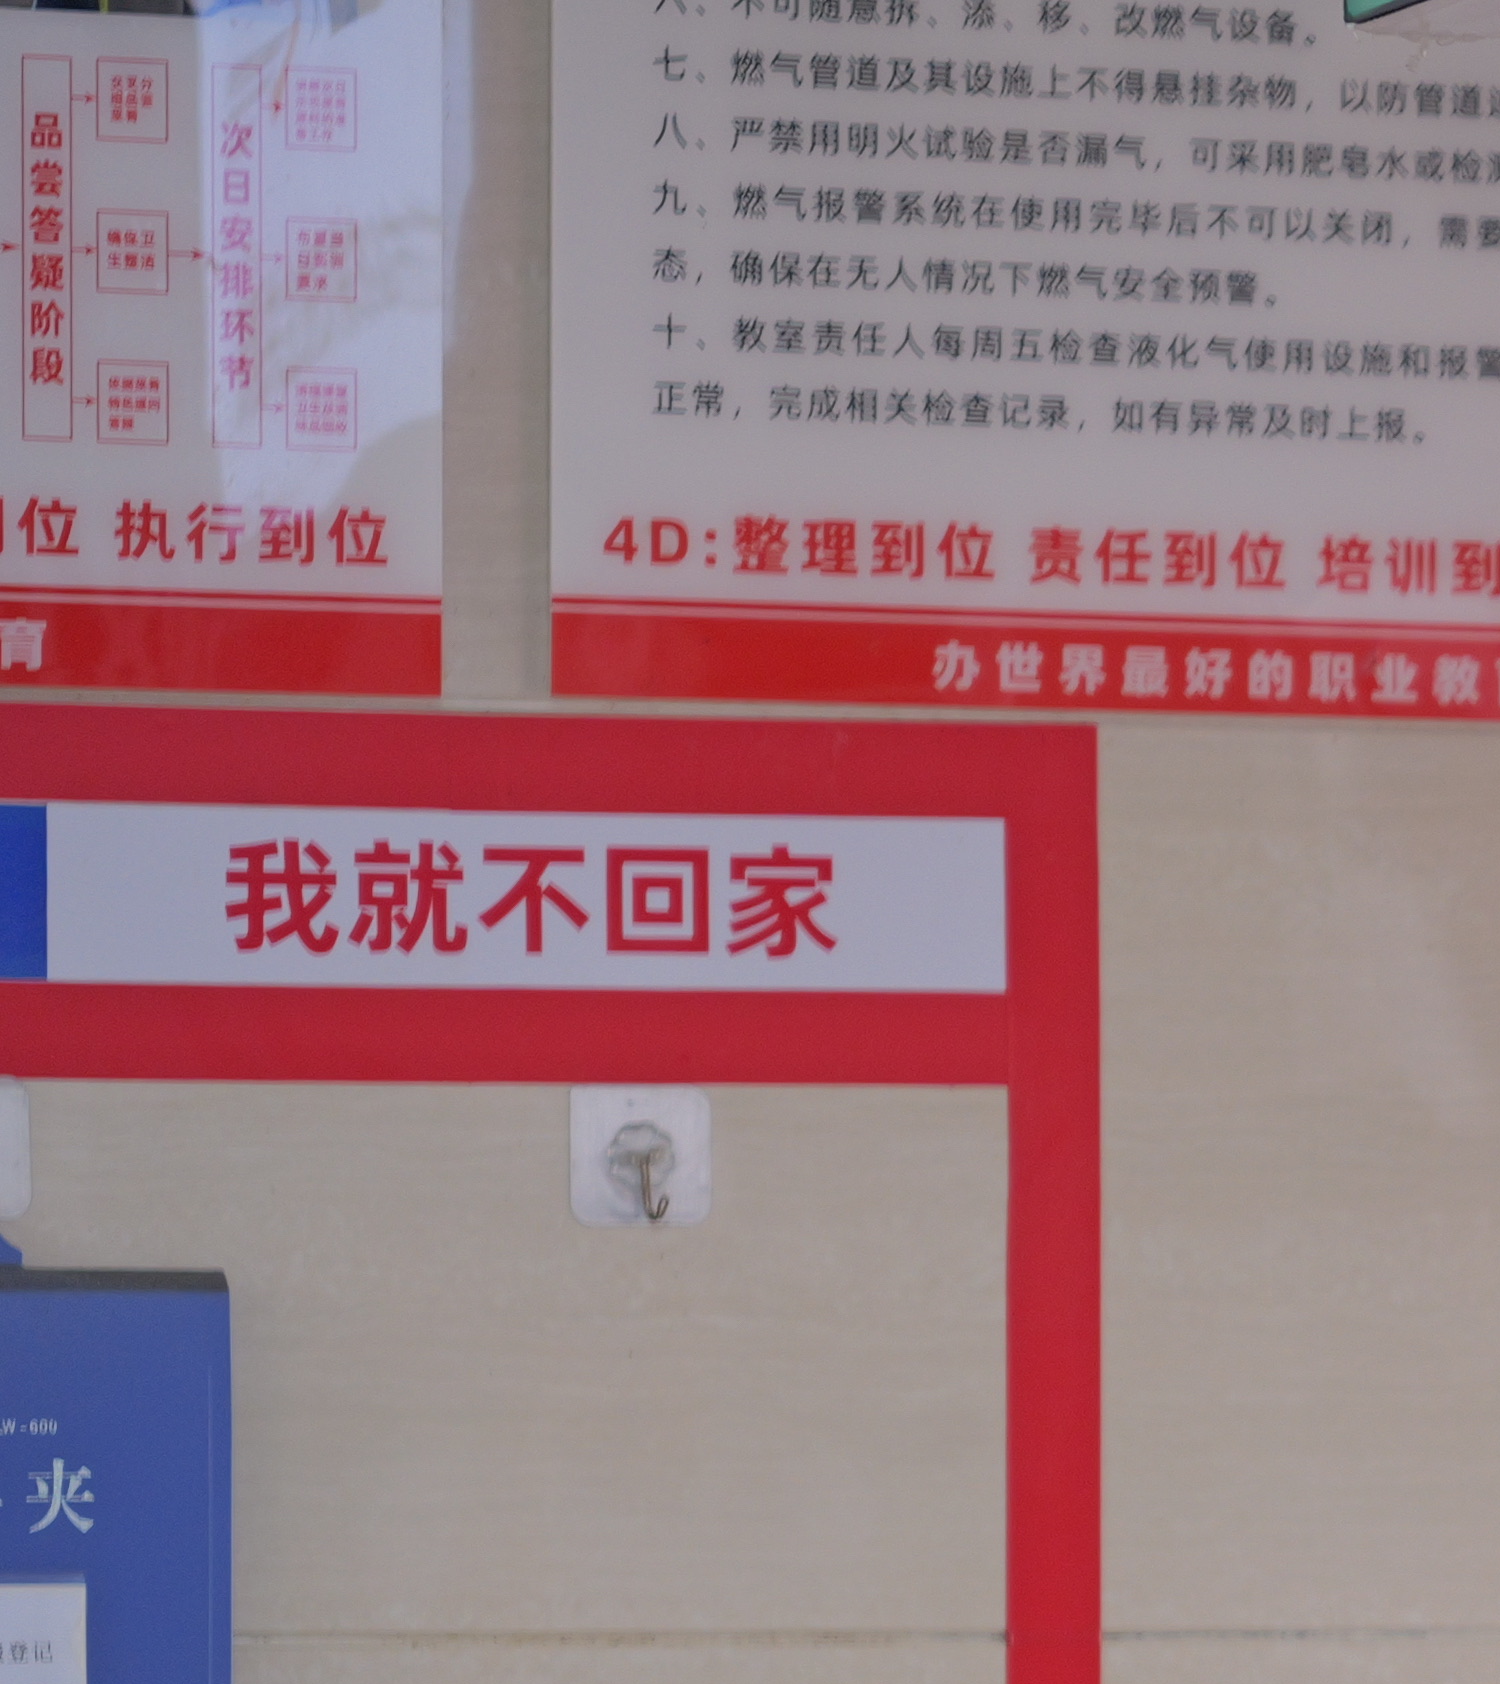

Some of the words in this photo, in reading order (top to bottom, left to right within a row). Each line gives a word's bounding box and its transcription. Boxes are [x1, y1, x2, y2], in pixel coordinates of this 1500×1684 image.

[30, 113, 65, 386] 品尝答疑阶段
[220, 120, 255, 391] 次日安排环节
[0, 496, 80, 558] 位
[114, 499, 389, 566] 执行到位
[1029, 526, 1285, 587] 责任到位
[224, 838, 838, 959] 我就不回家
[26, 1457, 95, 1534] 夹
